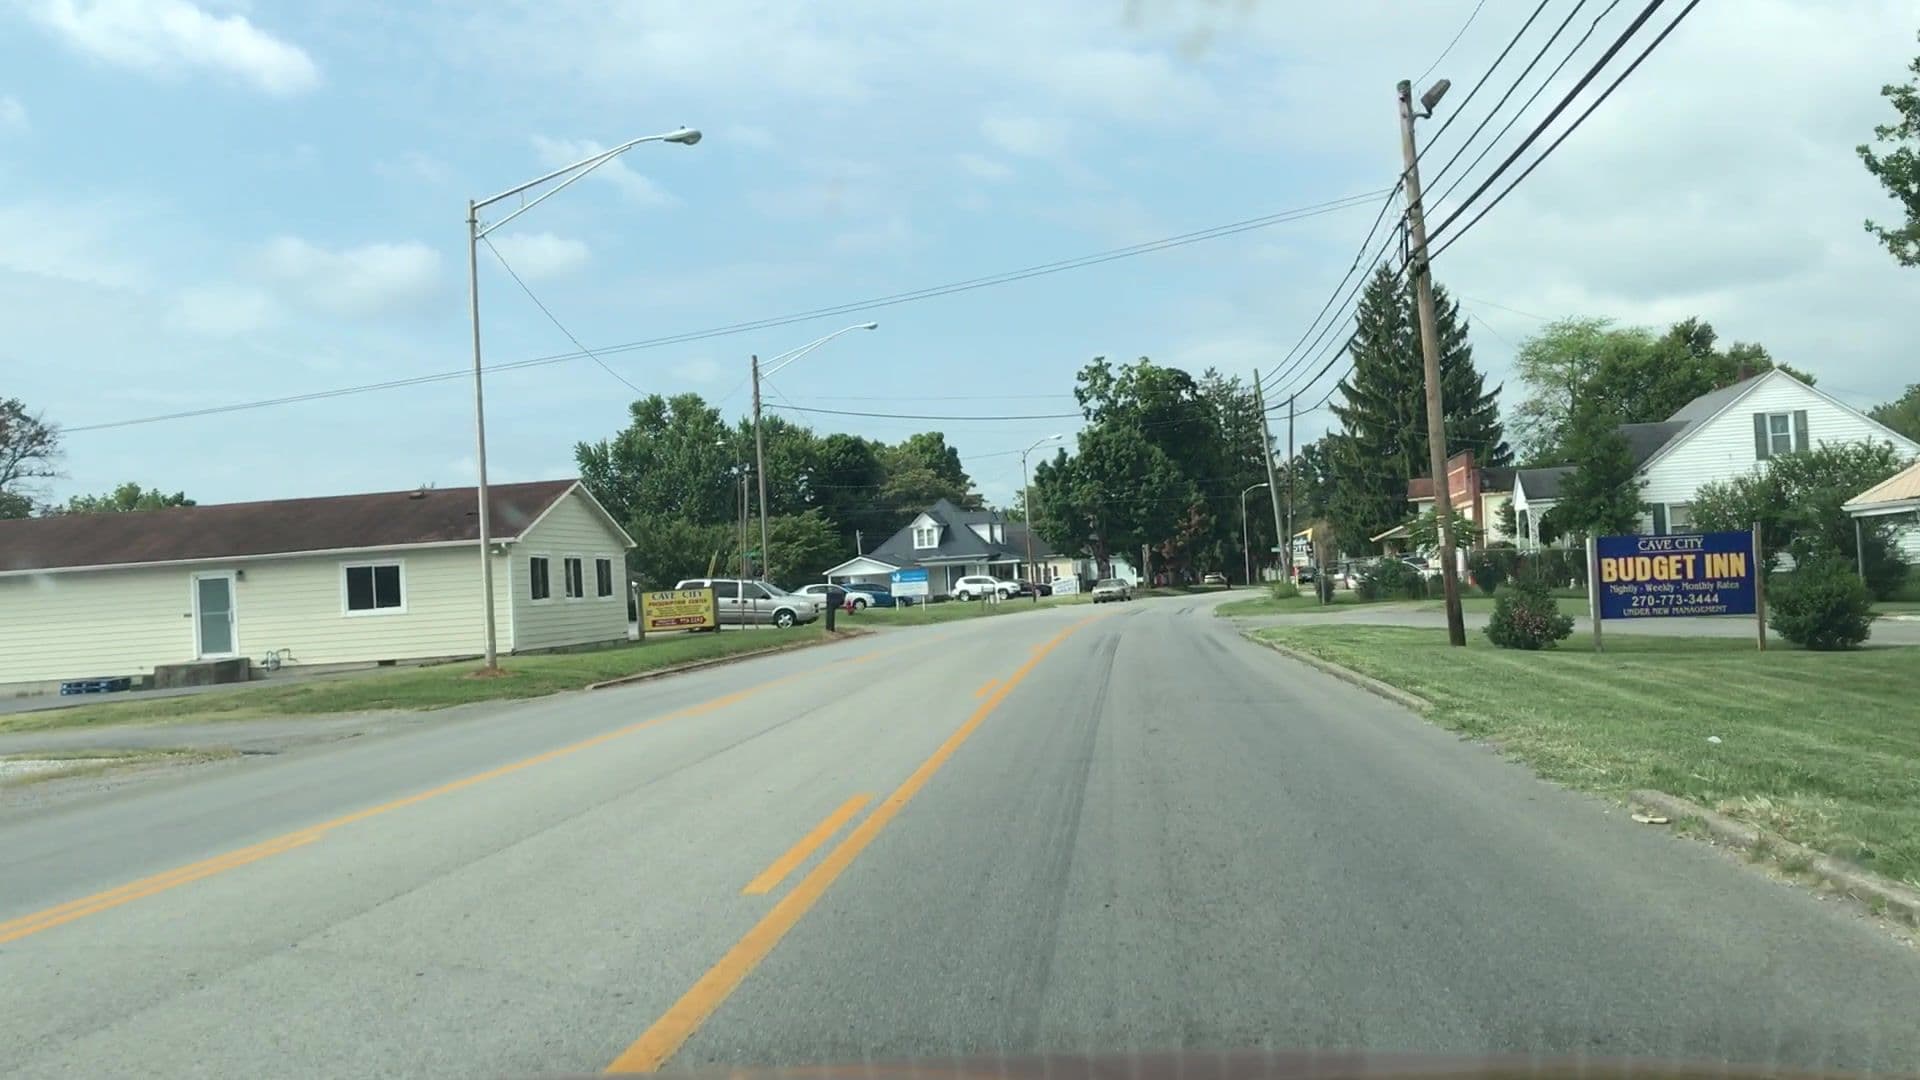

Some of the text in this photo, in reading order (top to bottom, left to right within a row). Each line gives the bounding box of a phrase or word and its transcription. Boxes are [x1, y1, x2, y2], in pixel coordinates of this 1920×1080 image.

[1638, 537, 1704, 551] CAVE CITY
[1601, 552, 1746, 583] BUDGET INN
[1610, 584, 1638, 595] Nightly
[1645, 583, 1675, 593] Weekly
[1682, 581, 1714, 592] Monthly
[651, 592, 674, 600] CAVE
[1632, 593, 1719, 607] 270-773-3444
[1623, 605, 1728, 617] UNDER NEW MANAGEMENT
